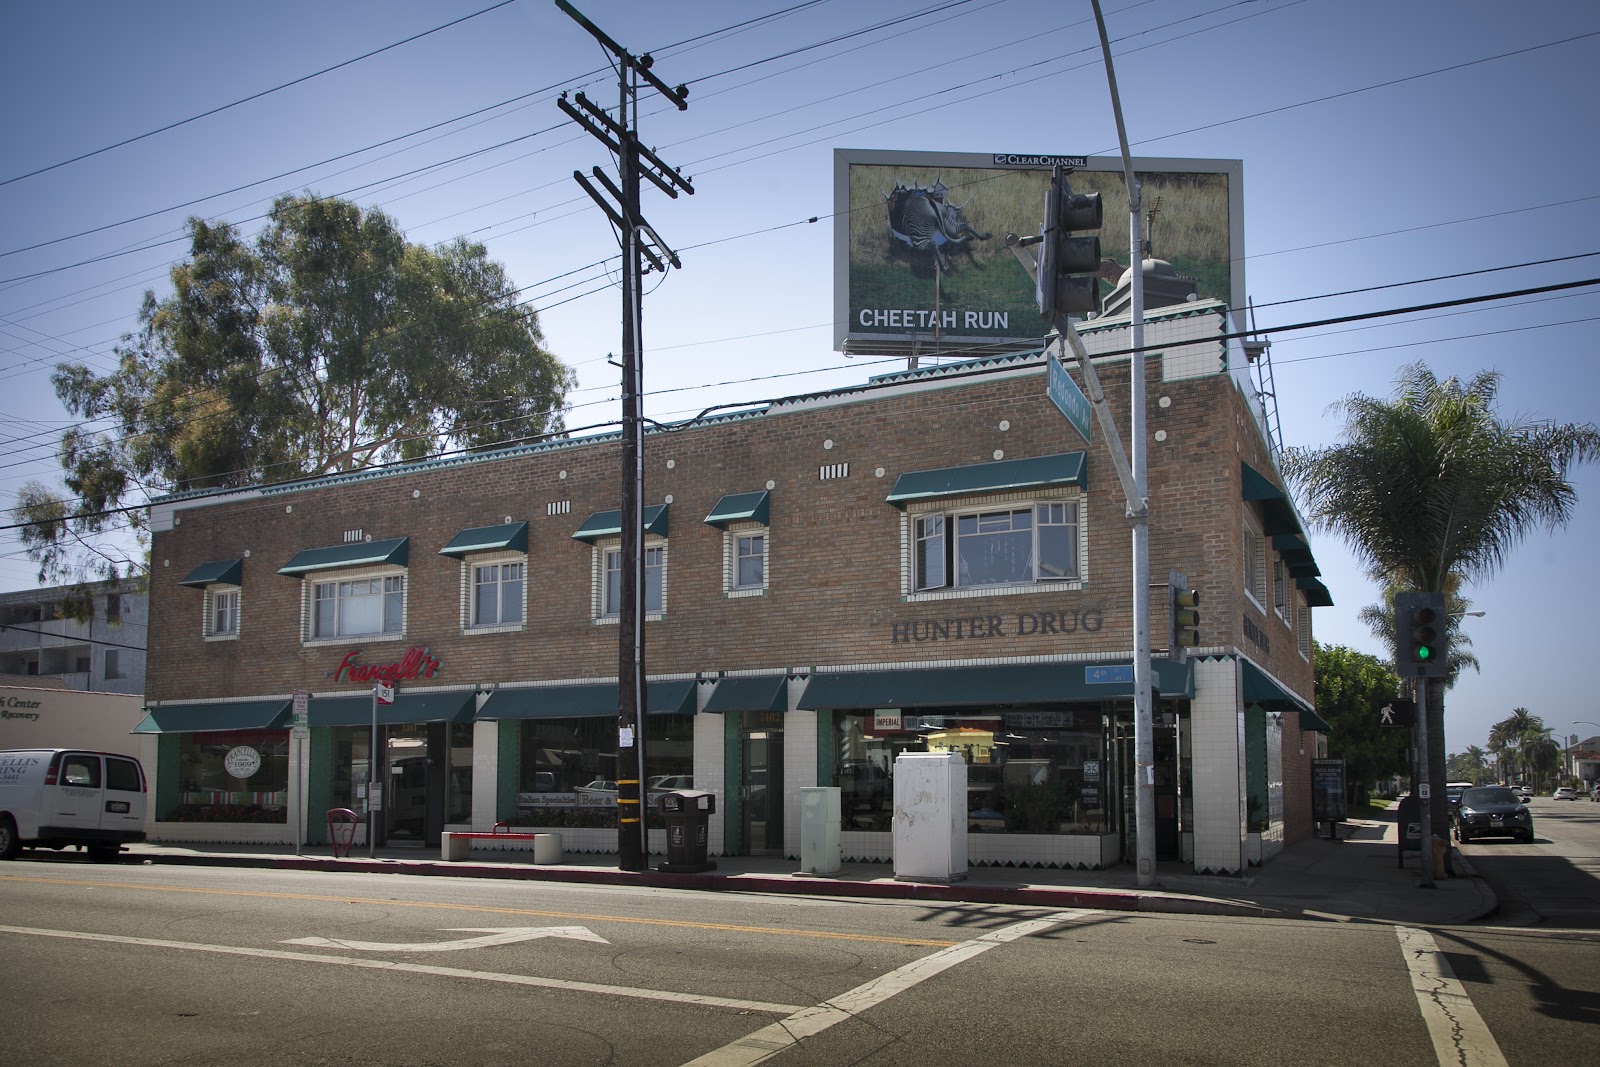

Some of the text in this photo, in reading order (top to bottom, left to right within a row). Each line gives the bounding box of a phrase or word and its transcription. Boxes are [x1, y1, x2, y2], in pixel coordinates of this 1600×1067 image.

[859, 308, 1009, 329] CHEETAH RUN
[1052, 369, 1080, 418] Redondo
[890, 609, 1104, 644] HUNTER DRUG
[381, 689, 390, 698] 151
[7, 696, 42, 709] Center
[1, 710, 40, 722] Recovery
[581, 794, 603, 805] Beer
